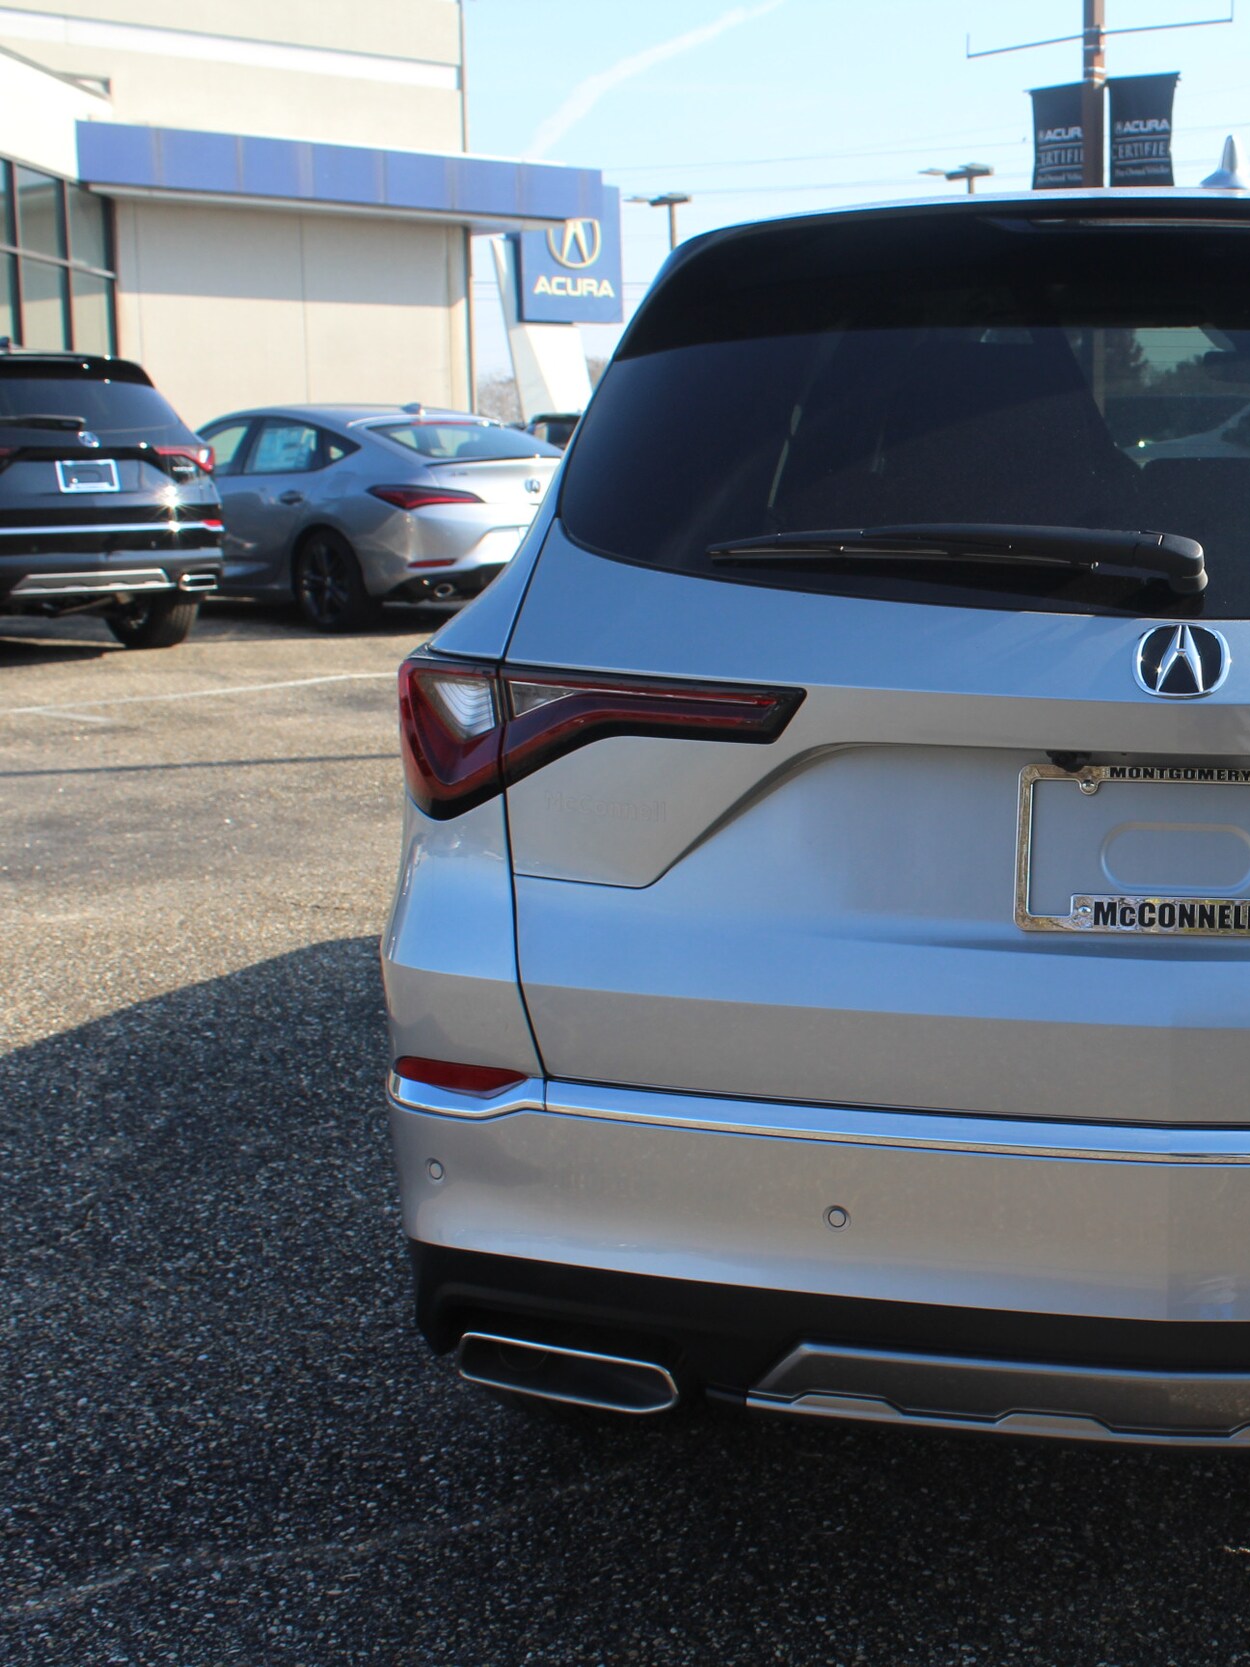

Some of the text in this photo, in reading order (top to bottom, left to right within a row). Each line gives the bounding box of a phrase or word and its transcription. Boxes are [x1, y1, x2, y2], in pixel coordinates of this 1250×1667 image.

[1045, 126, 1083, 142] ACUR
[1122, 118, 1170, 133] ACURA
[1112, 141, 1169, 160] CERTIFIE
[533, 275, 615, 298] ACURA
[544, 790, 667, 823] McConnell
